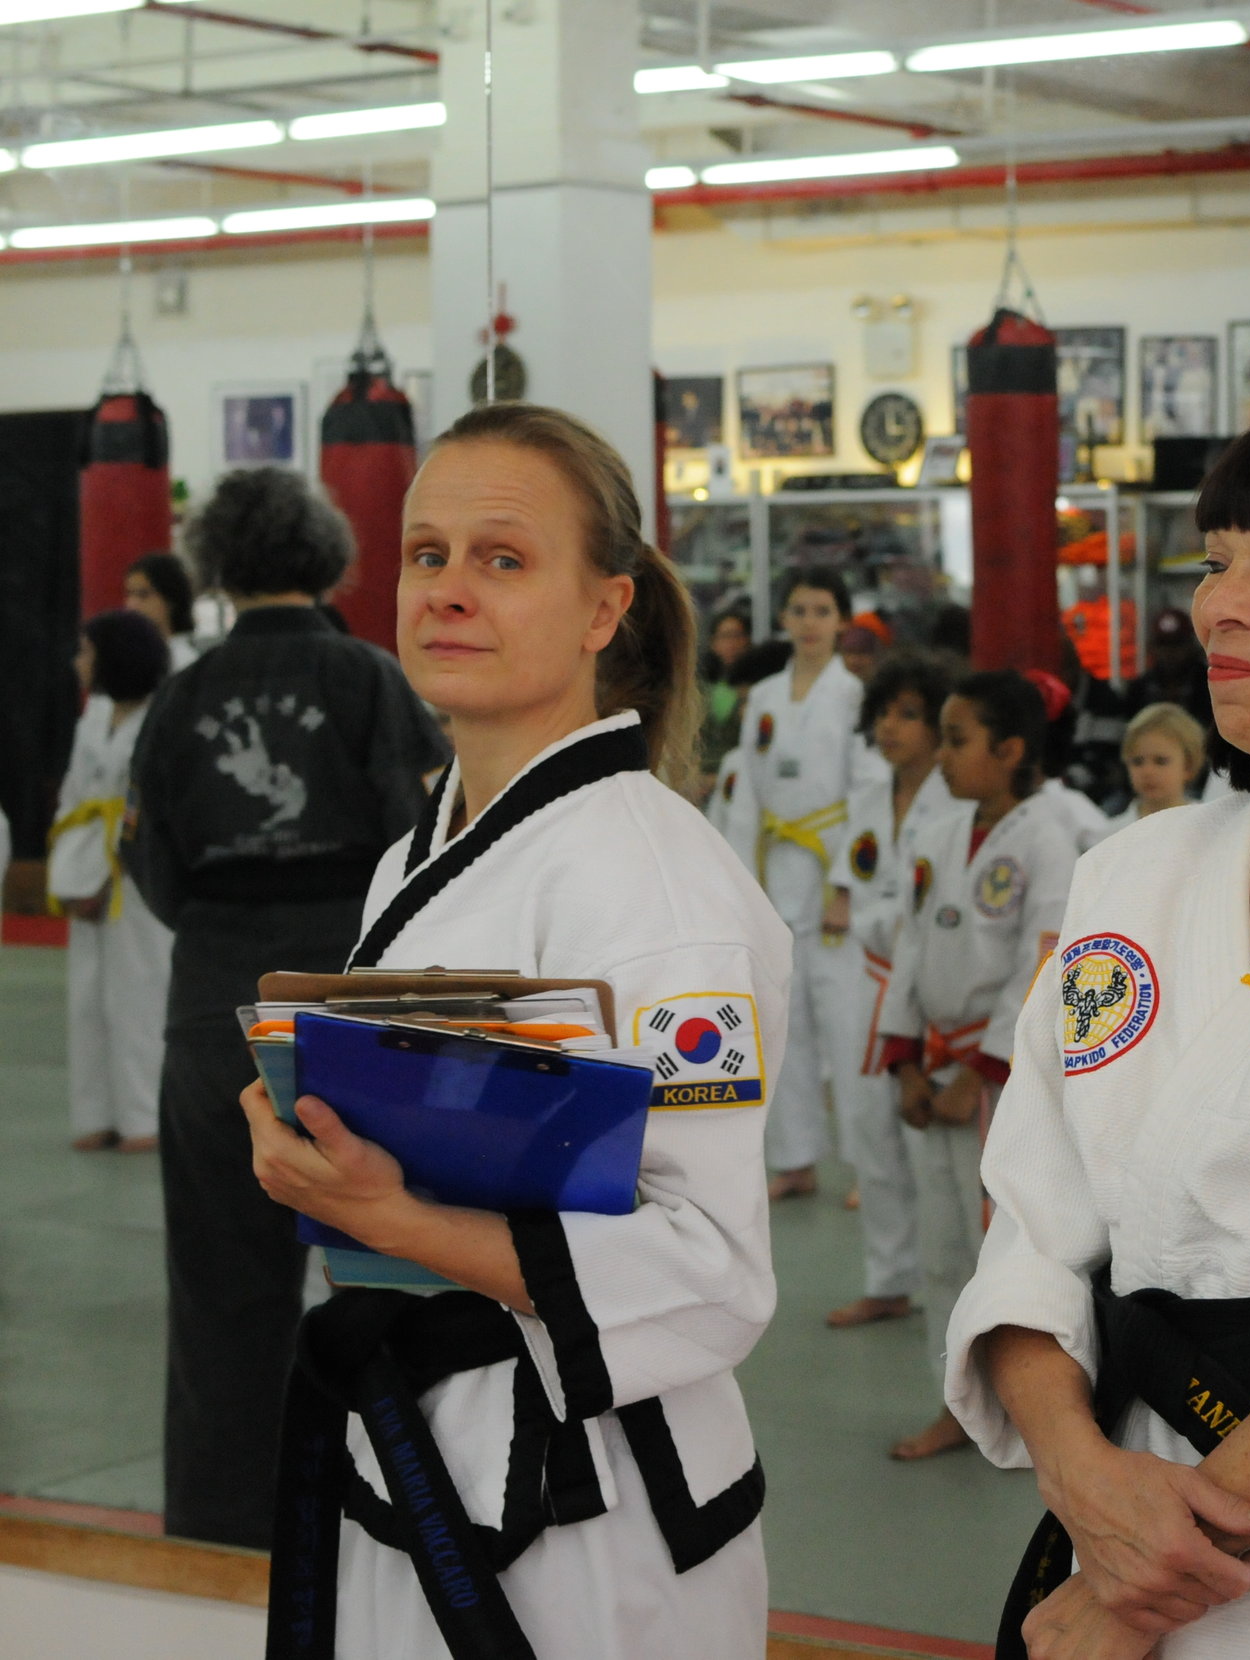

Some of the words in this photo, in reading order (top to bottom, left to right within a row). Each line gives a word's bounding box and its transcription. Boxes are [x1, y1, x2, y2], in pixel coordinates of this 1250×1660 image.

[1111, 983, 1152, 1048] FEDERATION
[663, 1084, 738, 1104] KOREA
[371, 1397, 403, 1438] EVA
[390, 1441, 435, 1513] MARIA
[417, 1512, 480, 1608] VACCARO
